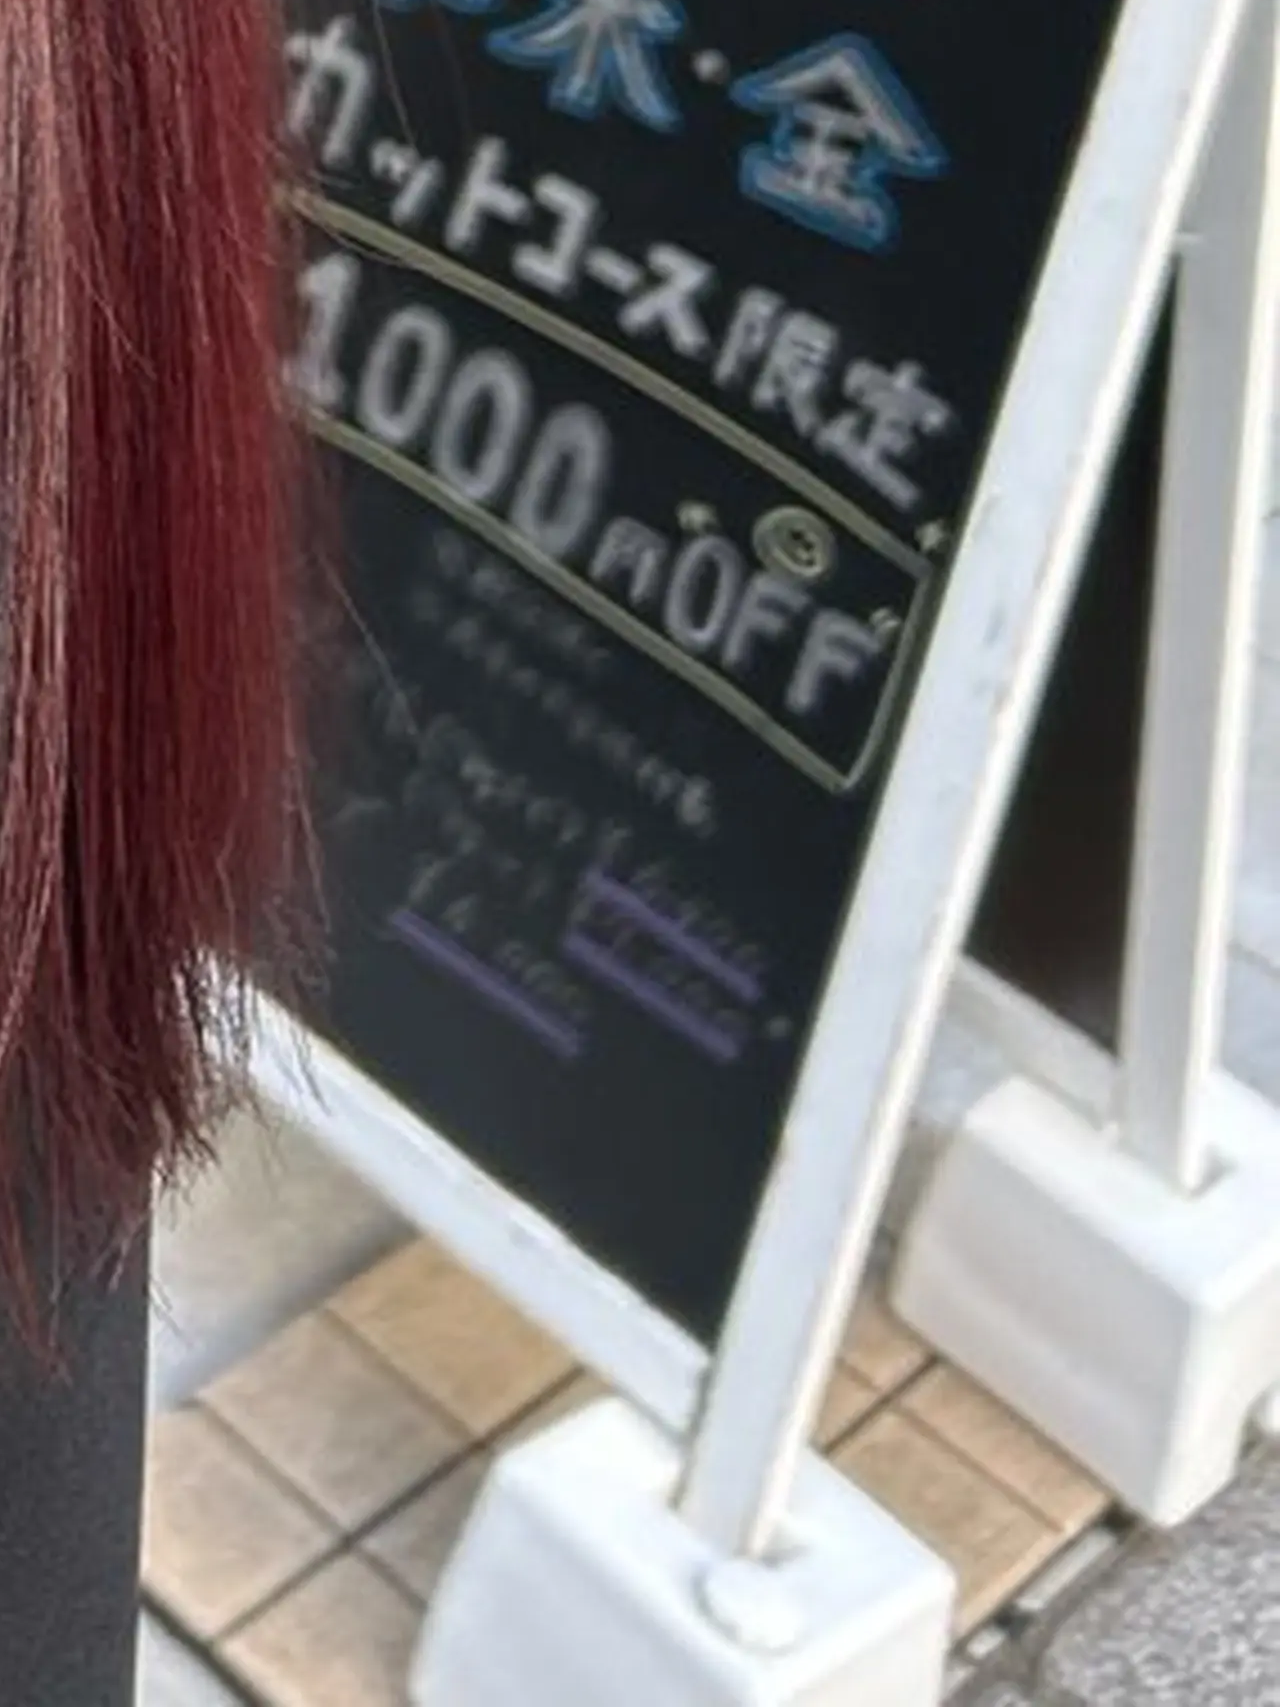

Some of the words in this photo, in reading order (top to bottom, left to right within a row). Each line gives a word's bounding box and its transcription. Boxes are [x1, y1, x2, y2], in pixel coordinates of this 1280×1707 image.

[283, 15, 957, 509] カットコース限定
[287, 251, 881, 715] 1000円OFF
